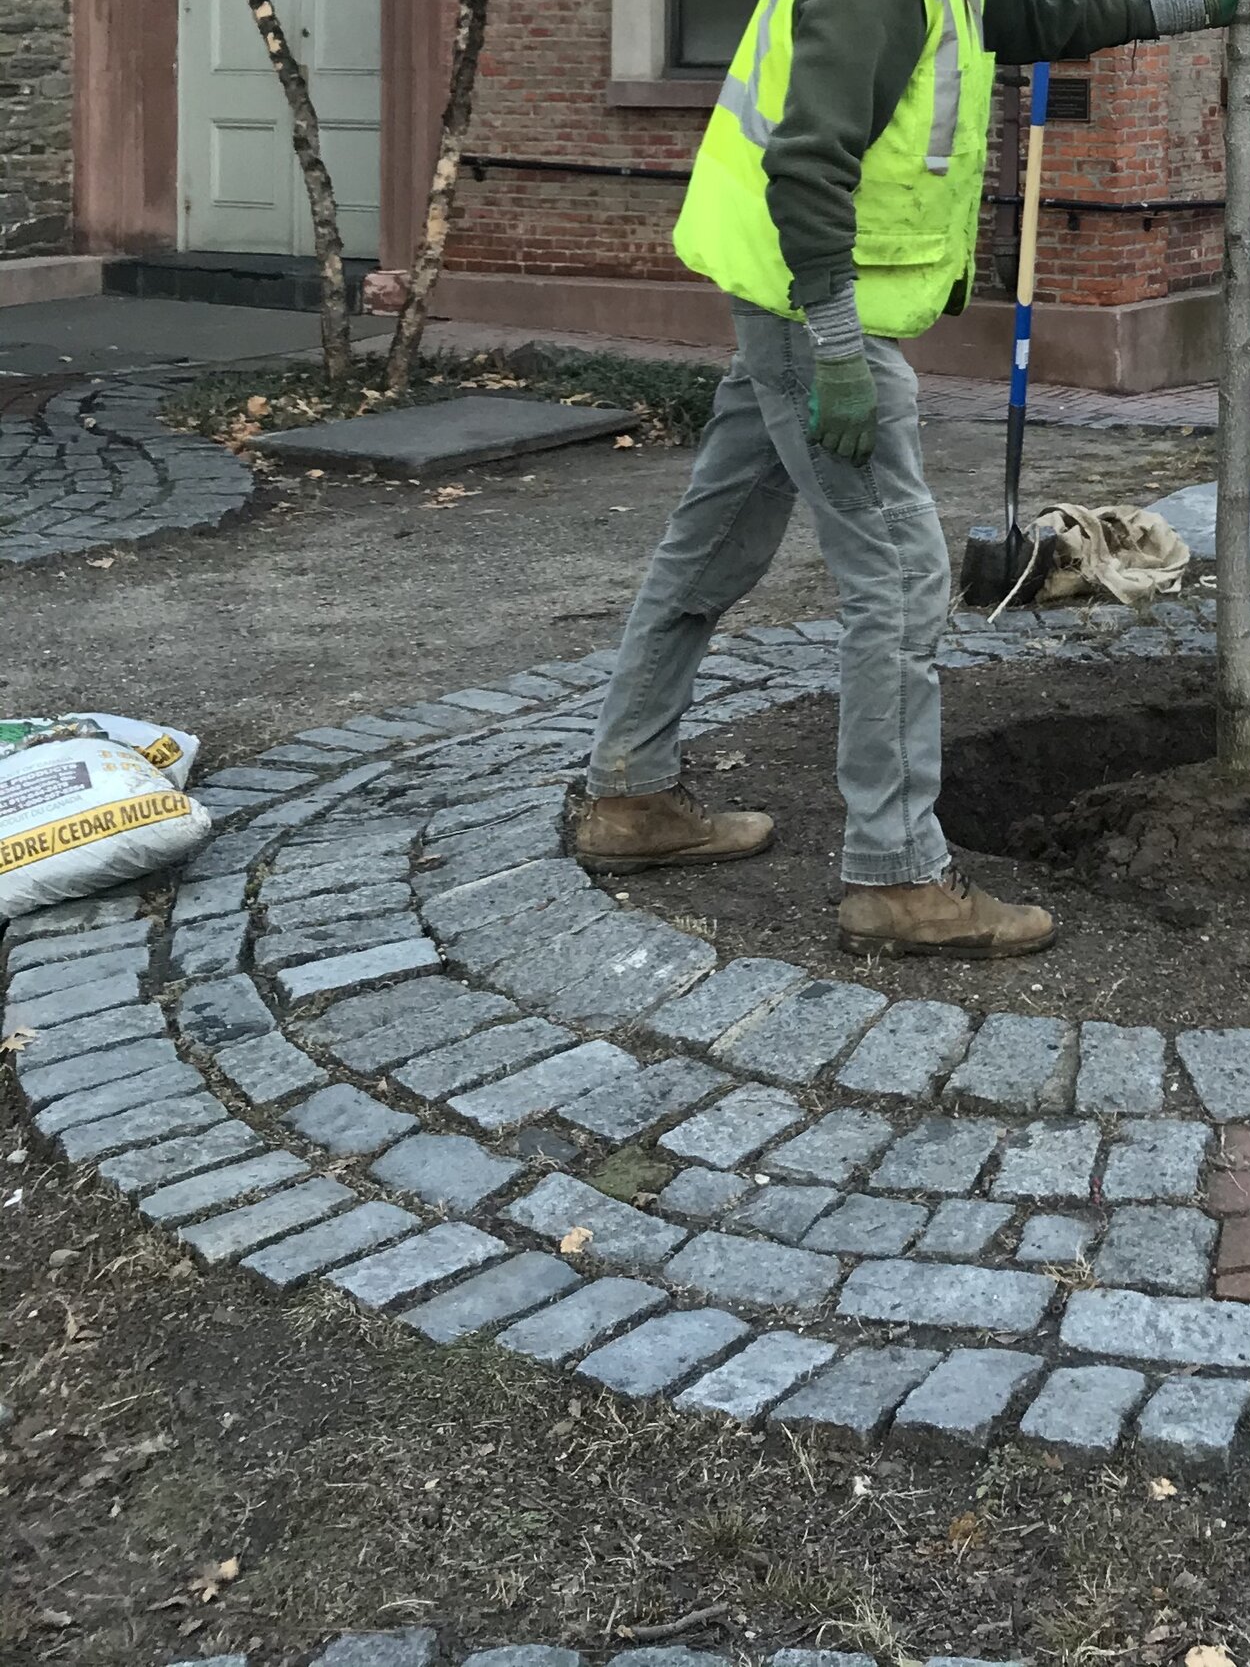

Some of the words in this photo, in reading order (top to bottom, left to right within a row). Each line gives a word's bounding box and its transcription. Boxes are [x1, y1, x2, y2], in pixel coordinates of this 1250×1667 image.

[46, 794, 83, 812] CANADA
[0, 809, 118, 868] ÈDRE/CEDAR
[120, 794, 187, 826] MULCH
